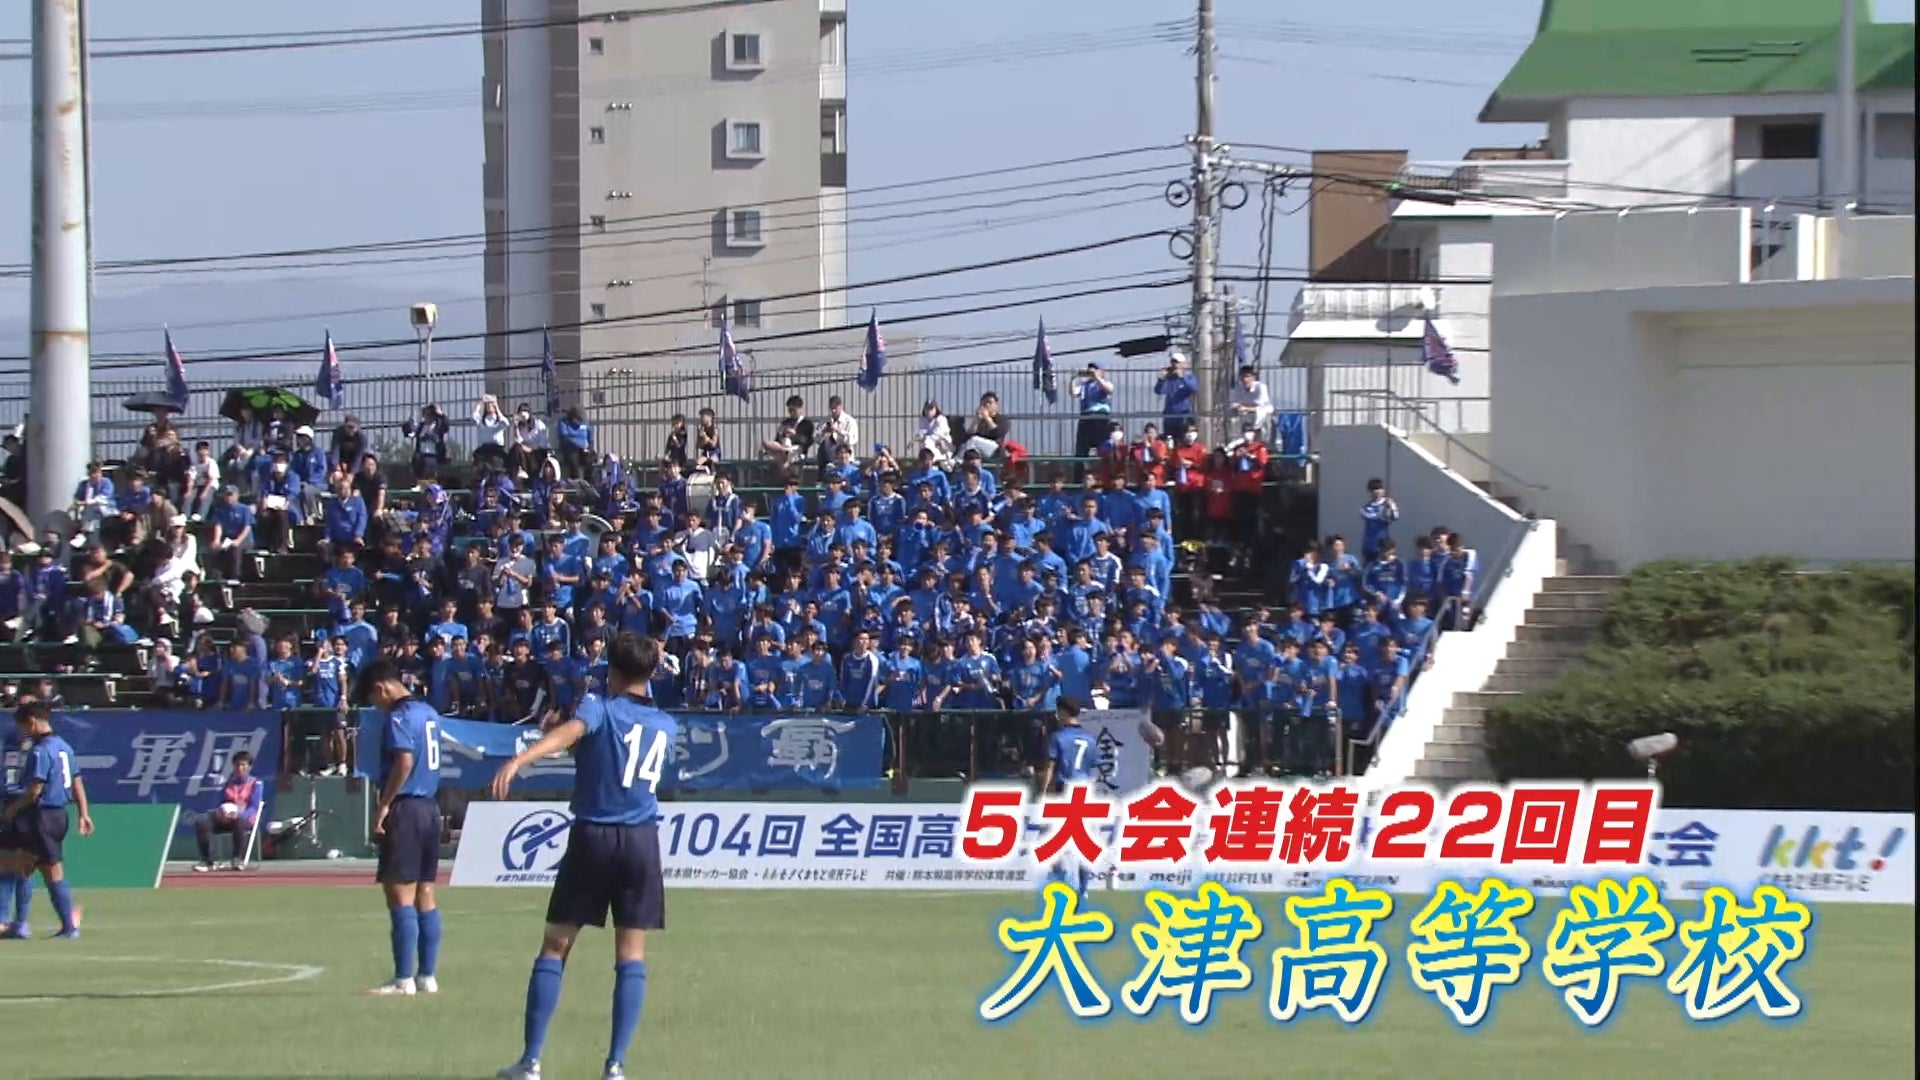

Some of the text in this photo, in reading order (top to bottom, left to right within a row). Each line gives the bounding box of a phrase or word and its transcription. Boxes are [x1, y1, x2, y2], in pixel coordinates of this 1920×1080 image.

[426, 721, 440, 771] 6
[622, 722, 669, 793] 14
[1073, 738, 1089, 770] 7
[656, 813, 806, 858] 104回
[1758, 824, 1906, 870] kkt!
[1149, 869, 1192, 884] meiji
